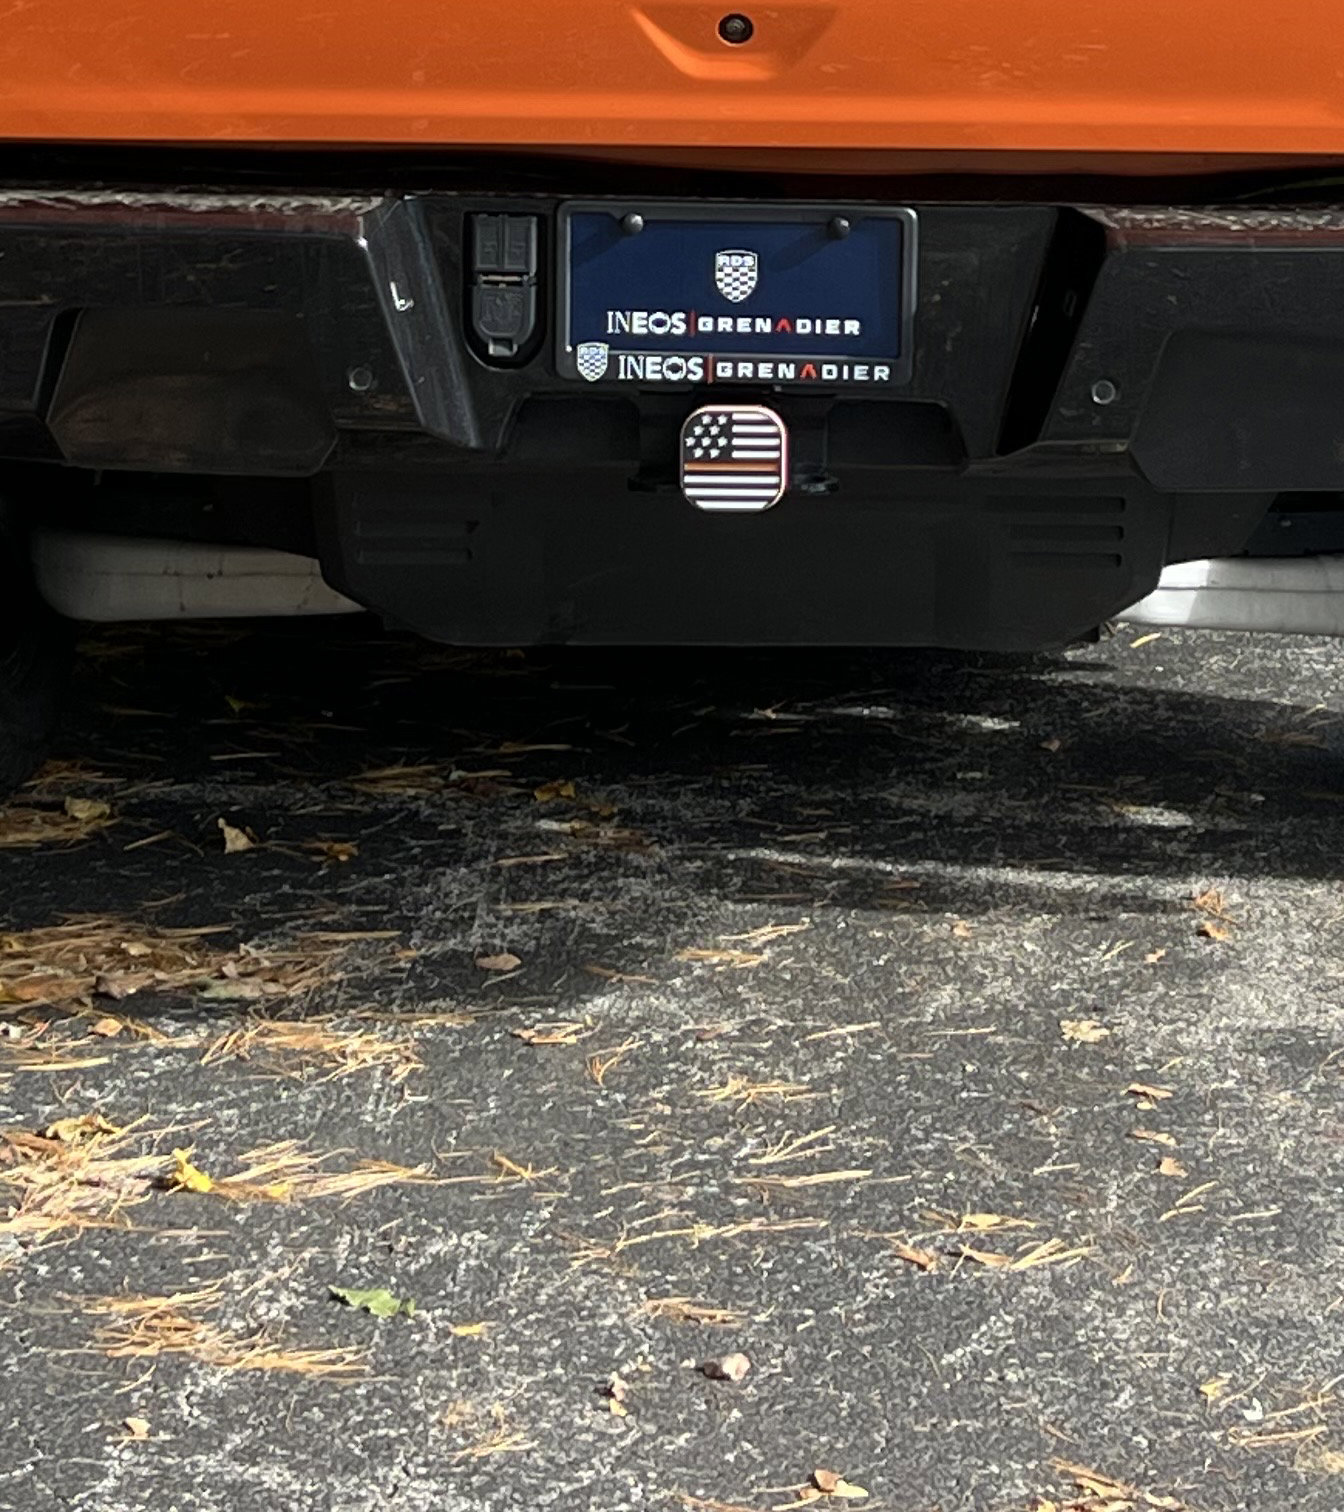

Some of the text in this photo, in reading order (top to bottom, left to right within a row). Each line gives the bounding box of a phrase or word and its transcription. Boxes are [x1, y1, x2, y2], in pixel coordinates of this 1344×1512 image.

[717, 254, 755, 267] RDS
[606, 310, 862, 337] INEOS GRENADIER
[618, 354, 891, 382] INEOS GRENADIER
